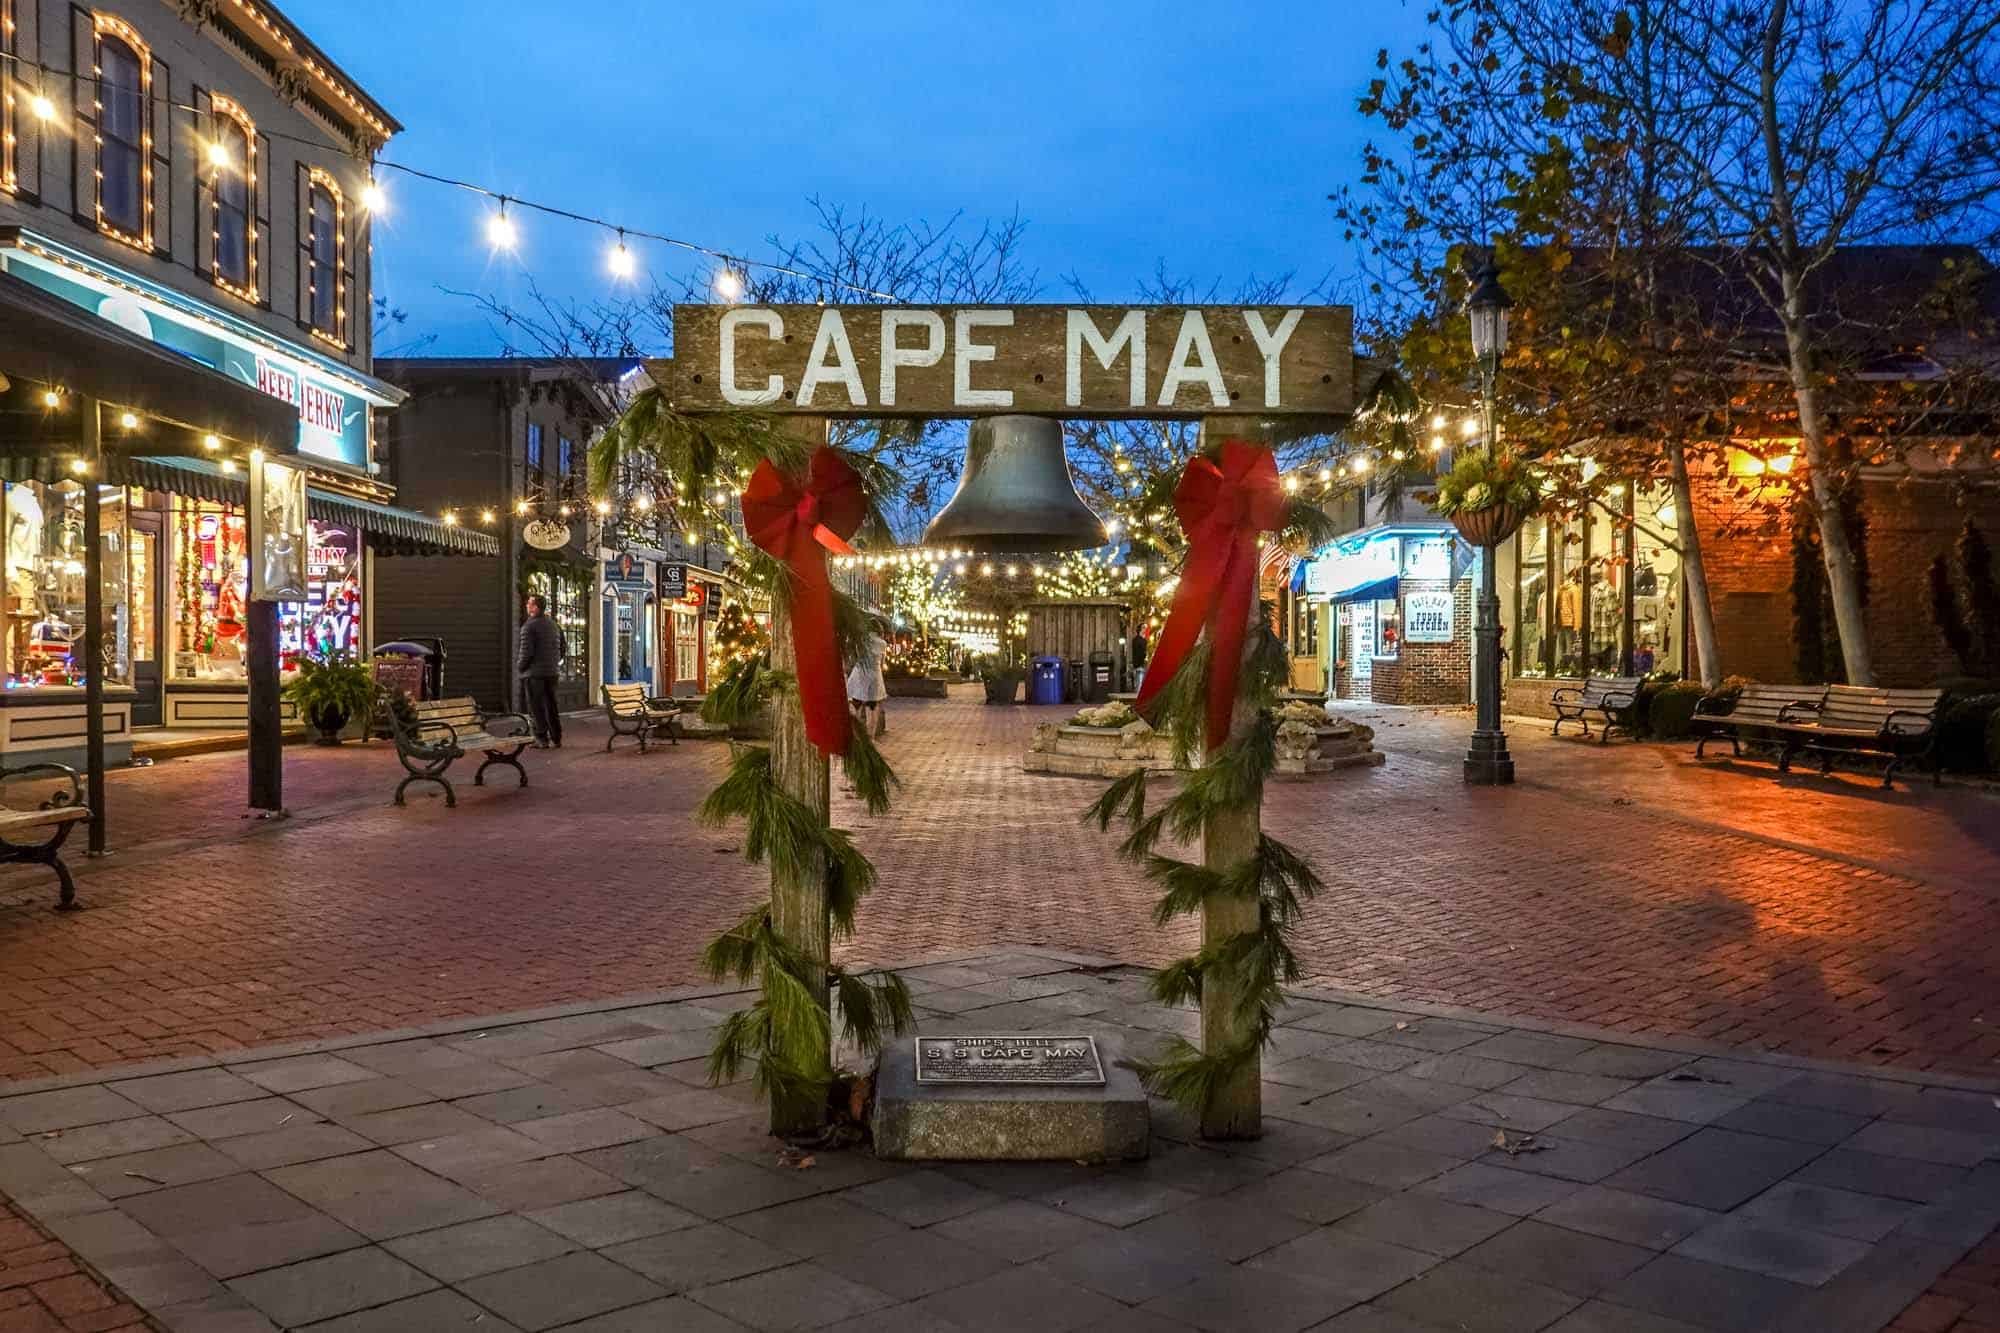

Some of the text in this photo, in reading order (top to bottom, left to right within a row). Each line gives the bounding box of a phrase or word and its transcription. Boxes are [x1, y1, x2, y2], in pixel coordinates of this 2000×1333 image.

[718, 308, 1304, 408] CAPE MAY
[300, 379, 343, 433] JERKY
[1416, 612, 1443, 622] FUDGE
[1409, 621, 1449, 631] KITCHEN
[981, 1048, 1033, 1058] CAPE
[1045, 1048, 1086, 1058] MAY
